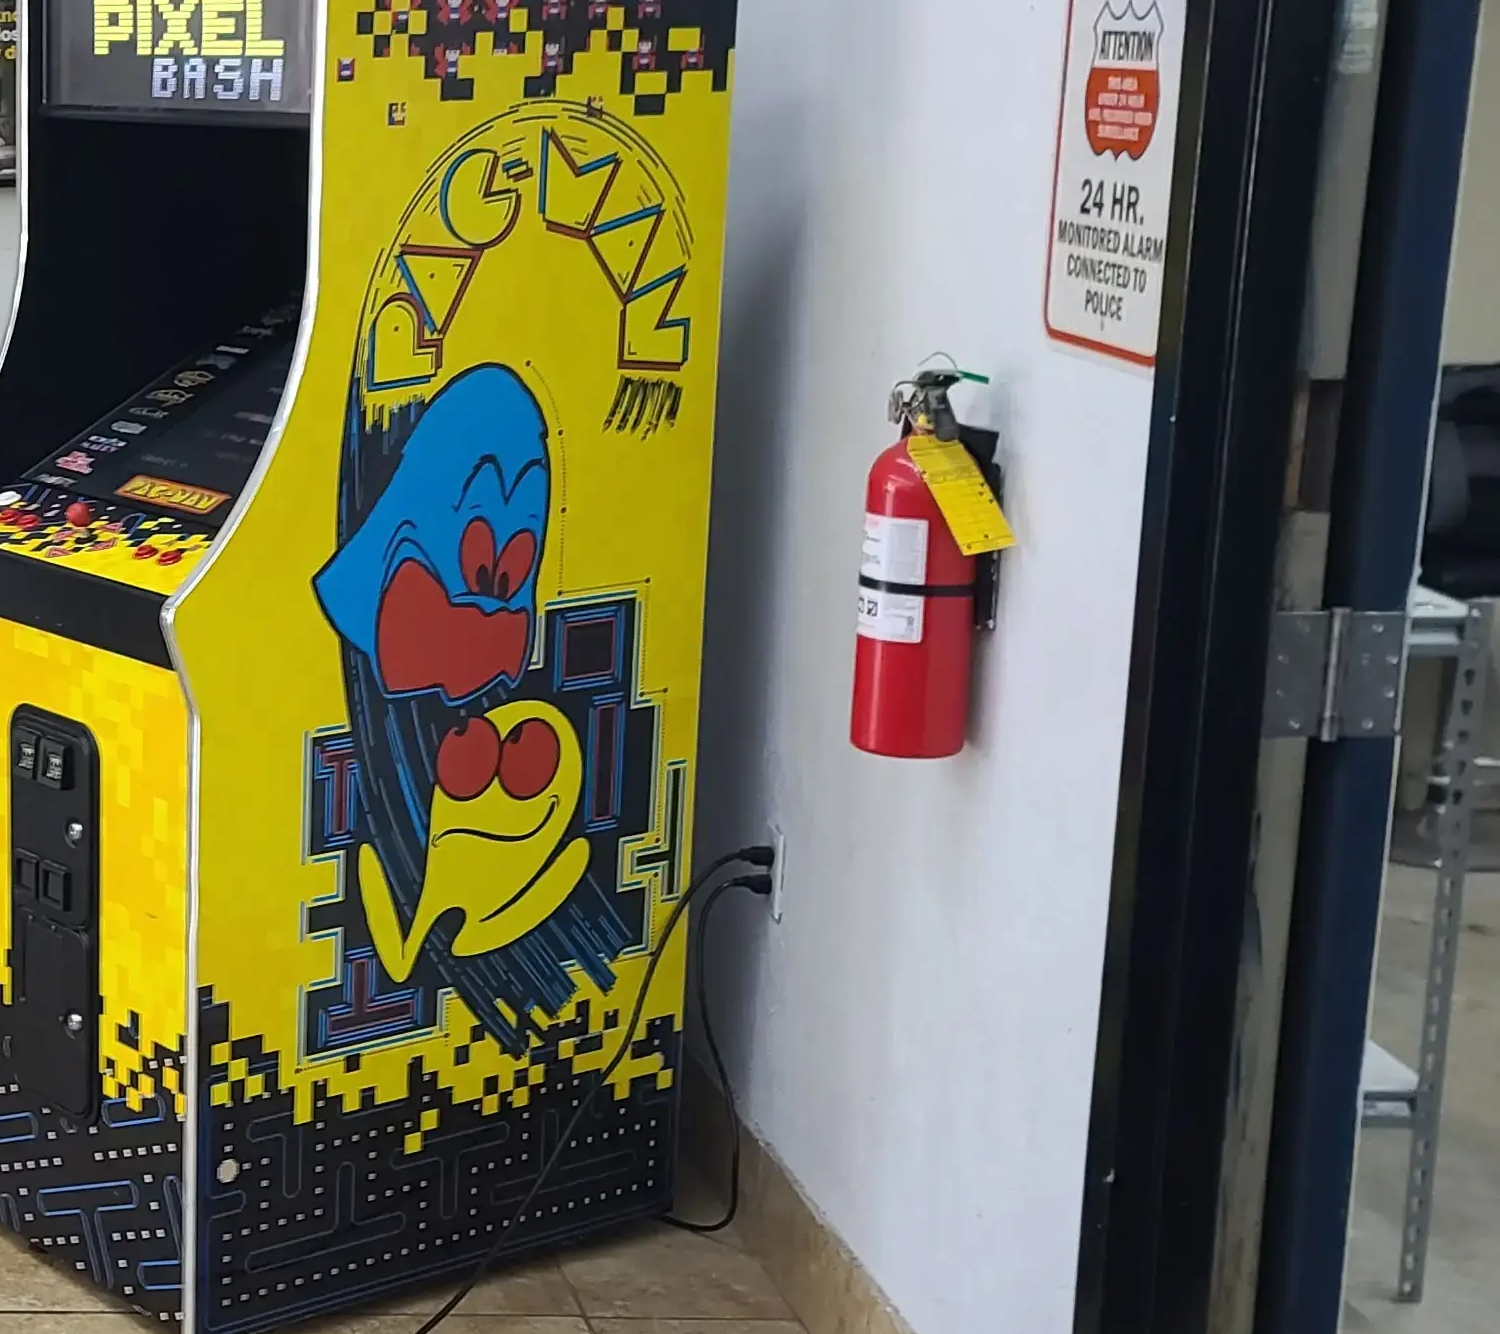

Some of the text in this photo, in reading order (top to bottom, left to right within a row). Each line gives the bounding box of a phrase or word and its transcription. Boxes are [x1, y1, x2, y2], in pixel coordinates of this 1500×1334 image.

[1100, 30, 1155, 62] ATTENTION
[151, 58, 284, 101] BASH
[1080, 179, 1144, 225] 24 HR.
[1058, 219, 1164, 262] MONITORED ALARM
[1067, 253, 1147, 293] CONNECTED TO
[1084, 289, 1123, 321] POLICE
[124, 478, 219, 511] PAC-MAN
